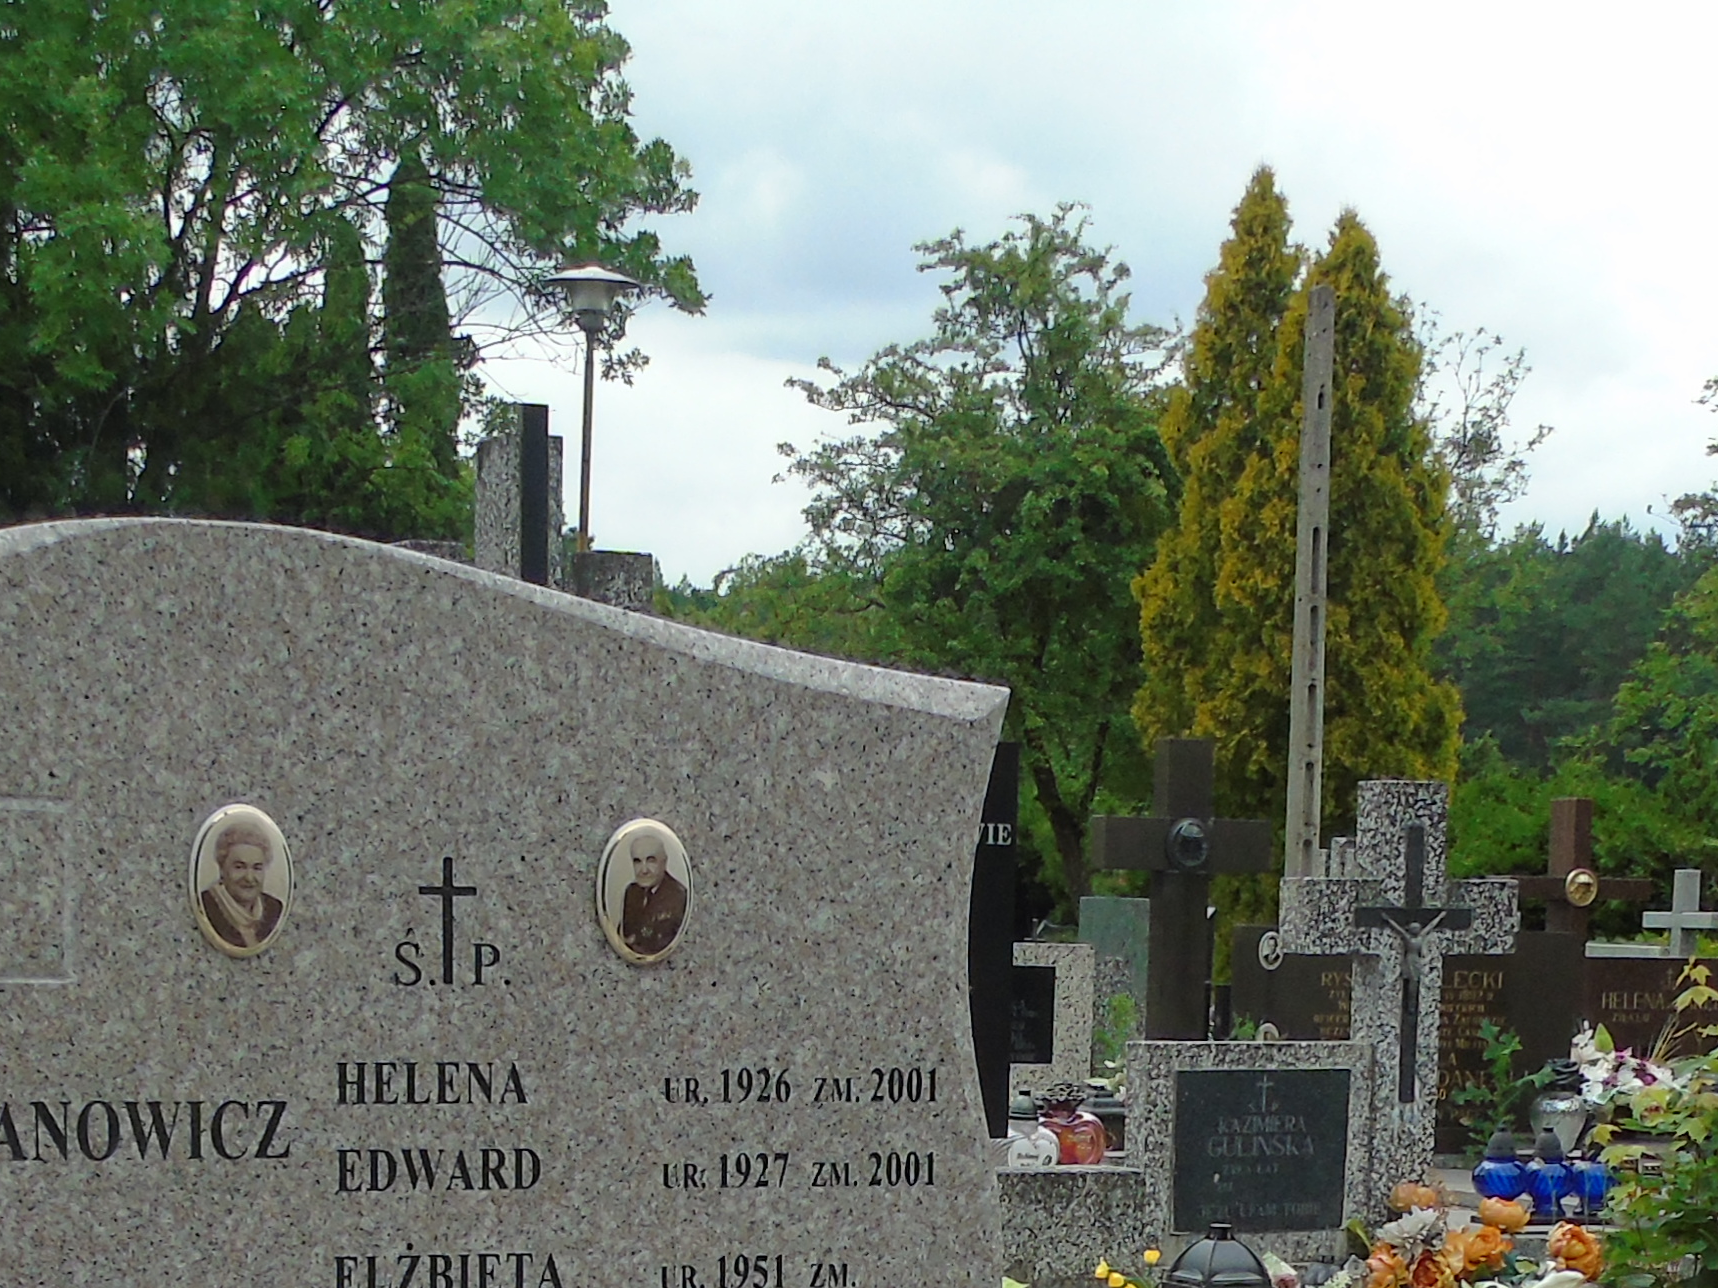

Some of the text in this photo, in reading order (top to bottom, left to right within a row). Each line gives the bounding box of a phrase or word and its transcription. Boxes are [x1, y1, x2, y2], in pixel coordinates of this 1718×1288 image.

[979, 823, 1012, 846] IE
[1443, 970, 1504, 990] ECKI
[336, 1061, 528, 1105] HELENA
[720, 1067, 792, 1104] 1926
[813, 1076, 861, 1103] ZM.
[870, 1067, 938, 1104] 2001
[334, 1147, 542, 1193] EDWARD
[719, 1152, 789, 1189] 1927
[811, 1162, 858, 1188] ZM.
[868, 1151, 935, 1188] 2001
[809, 1262, 857, 1288] ZM.
